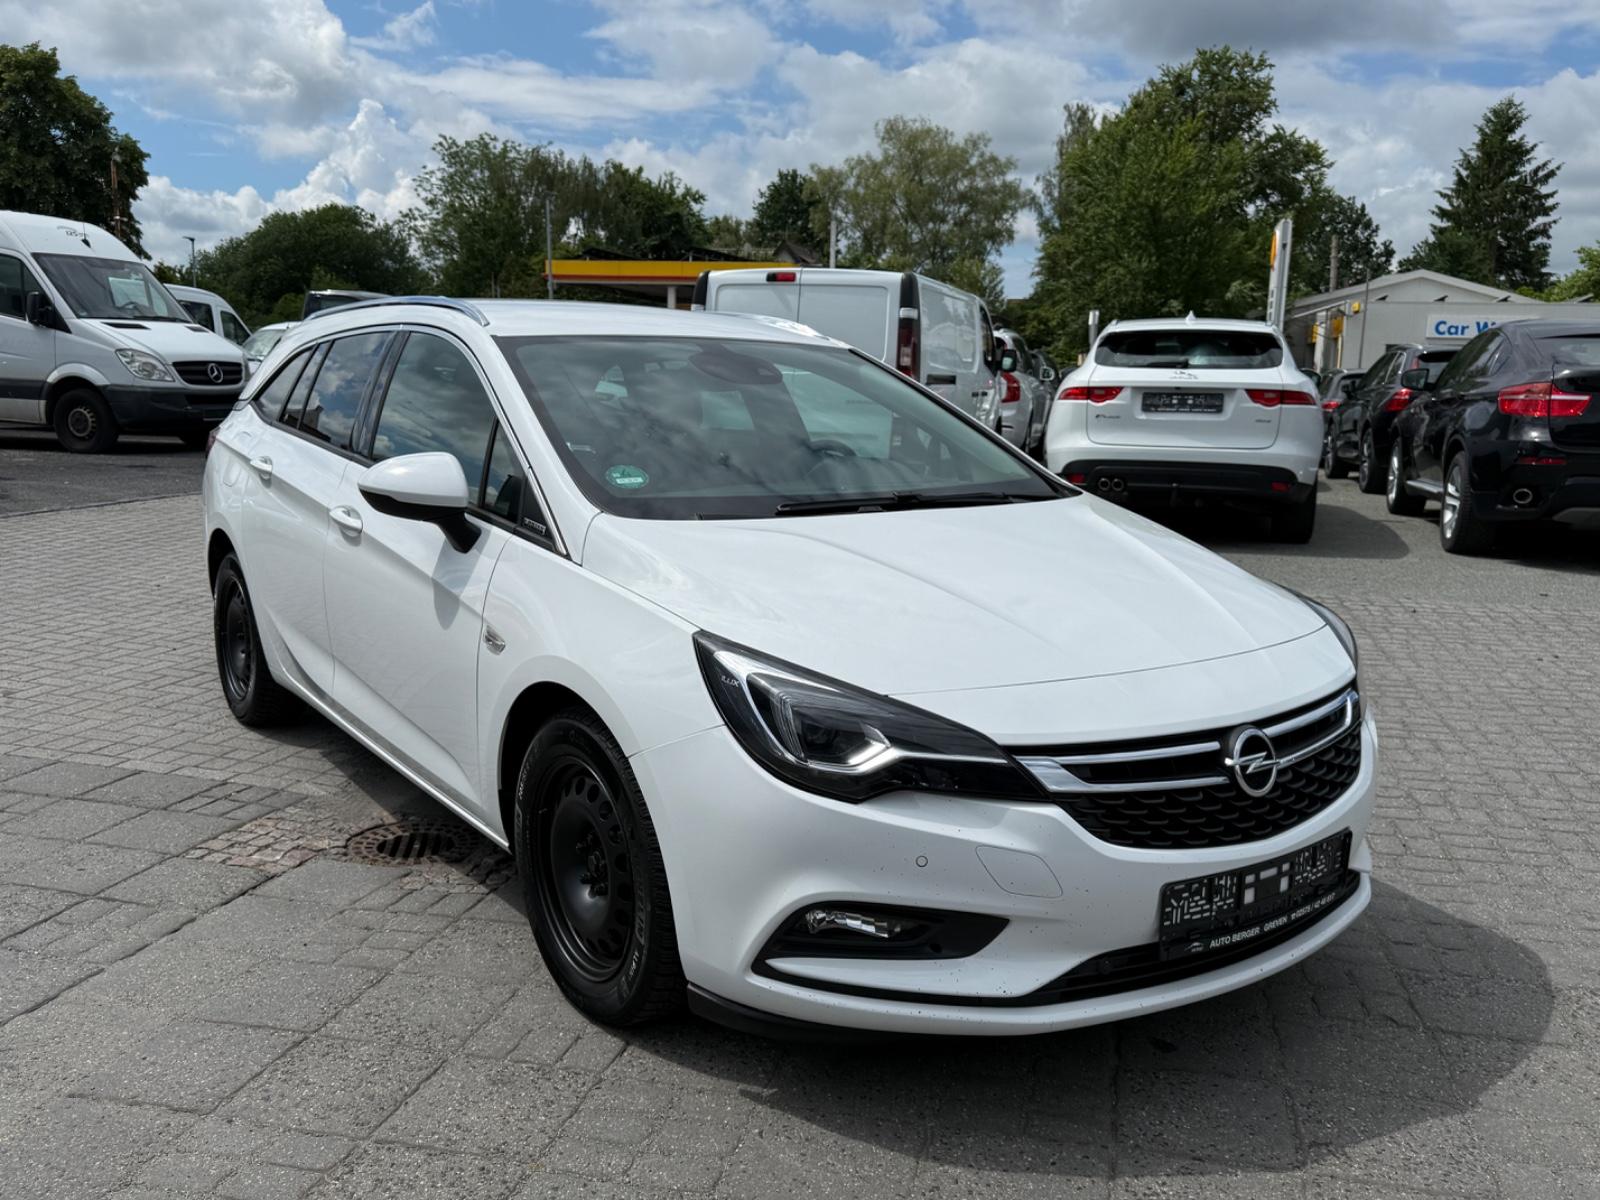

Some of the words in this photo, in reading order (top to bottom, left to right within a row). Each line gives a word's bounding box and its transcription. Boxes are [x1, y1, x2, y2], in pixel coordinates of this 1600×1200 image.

[1435, 320, 1469, 336] Car
[1209, 935, 1231, 950] AUTO
[1232, 926, 1260, 943] BERGER
[1263, 914, 1288, 932] GREVEN
